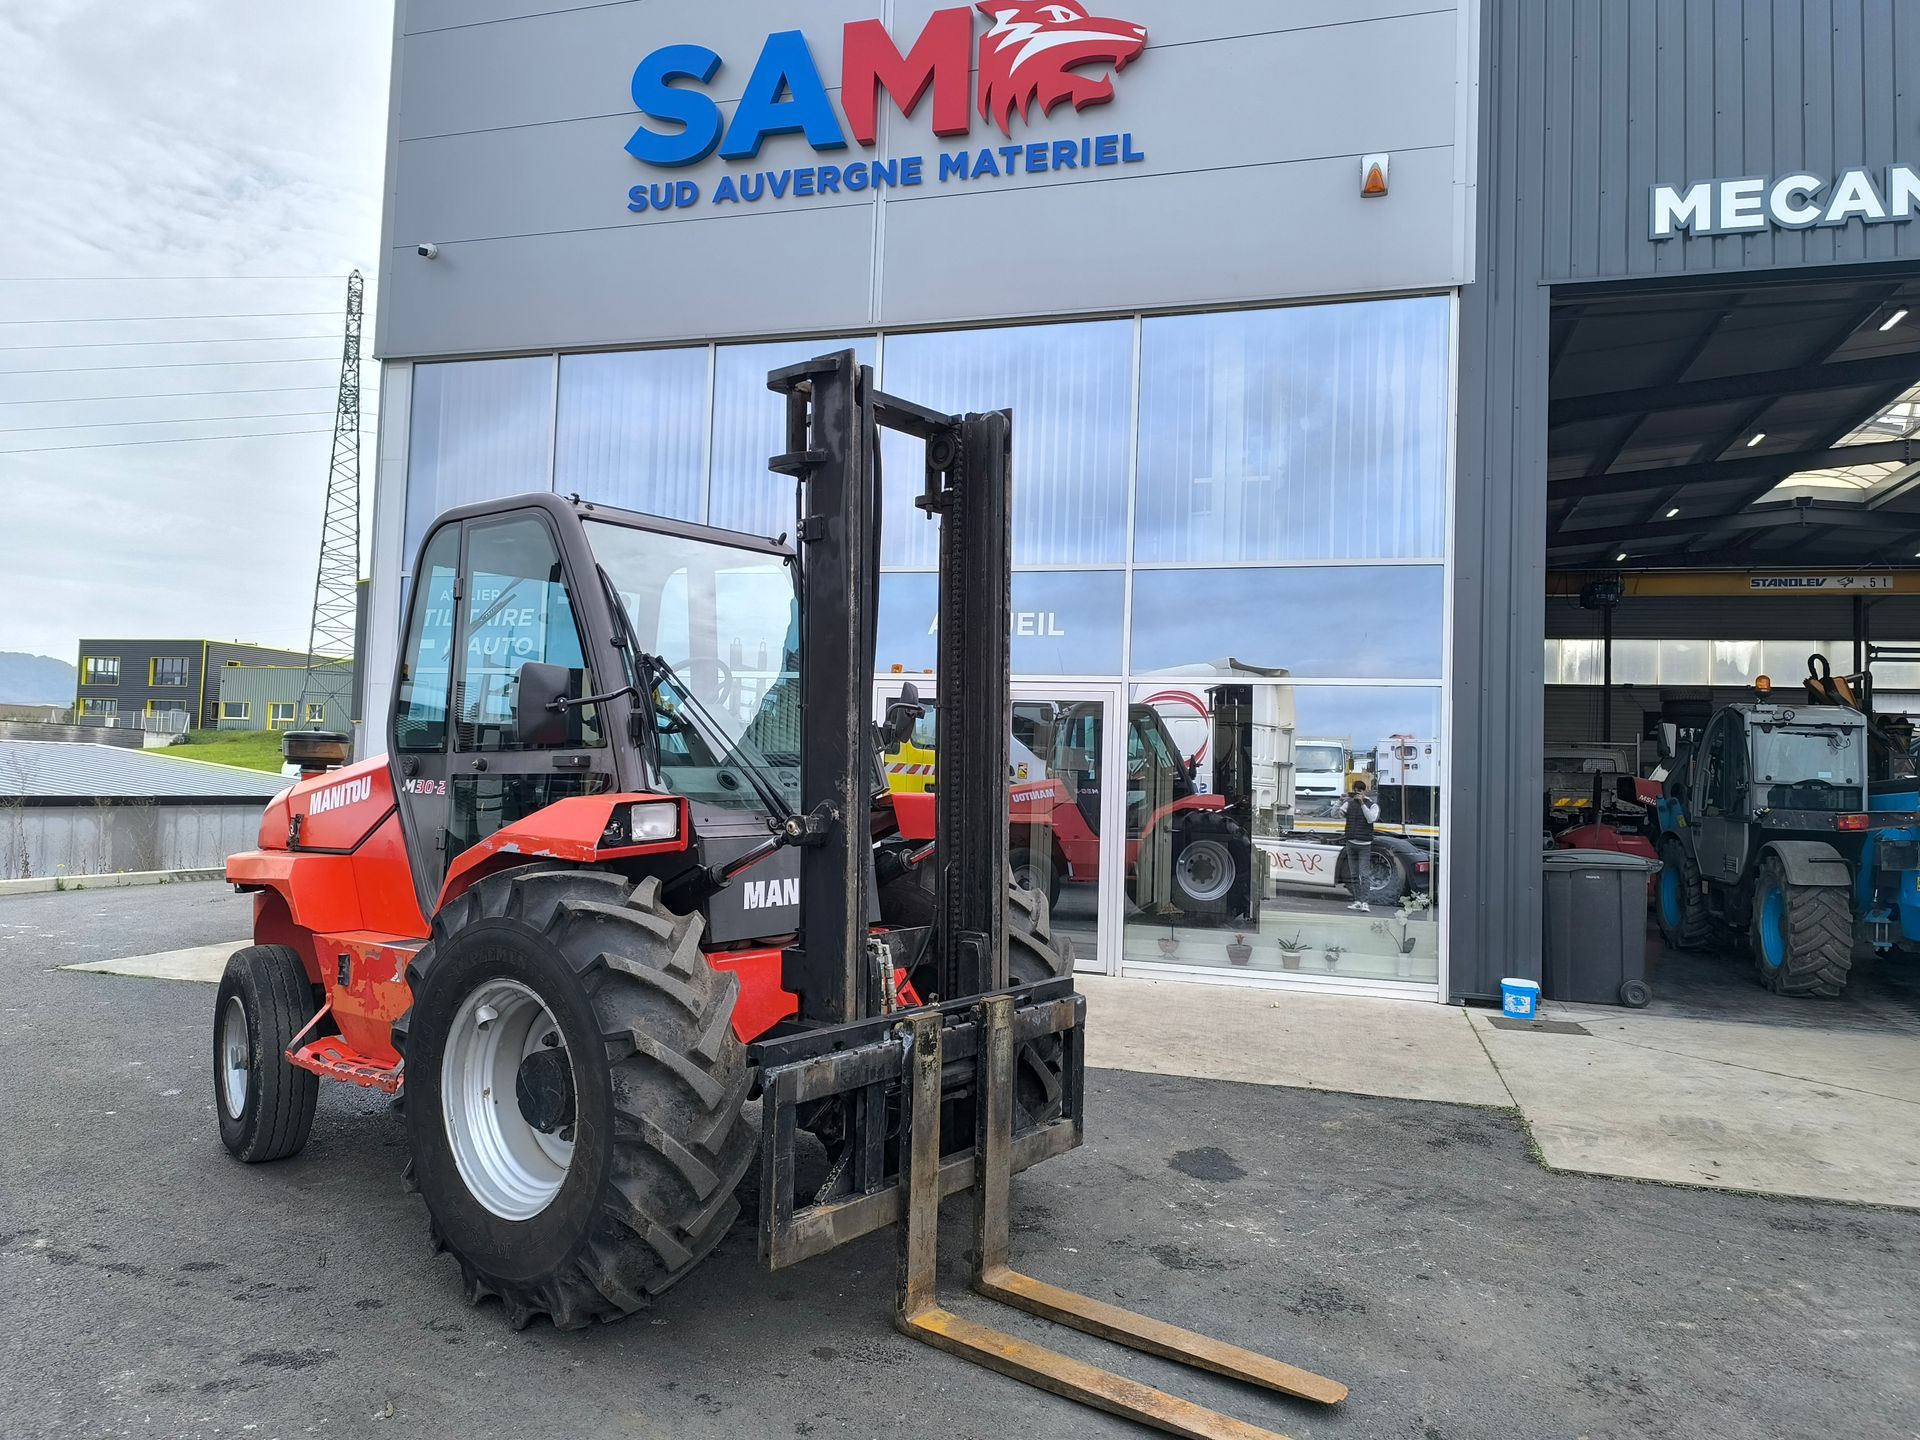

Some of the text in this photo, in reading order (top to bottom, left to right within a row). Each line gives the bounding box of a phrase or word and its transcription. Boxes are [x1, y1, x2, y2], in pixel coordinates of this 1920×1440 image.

[624, 6, 974, 168] SAM
[627, 133, 1145, 213] SUD AUVERGNE MATERIEL
[467, 637, 534, 656] AUTO
[309, 775, 372, 816] MANITOU
